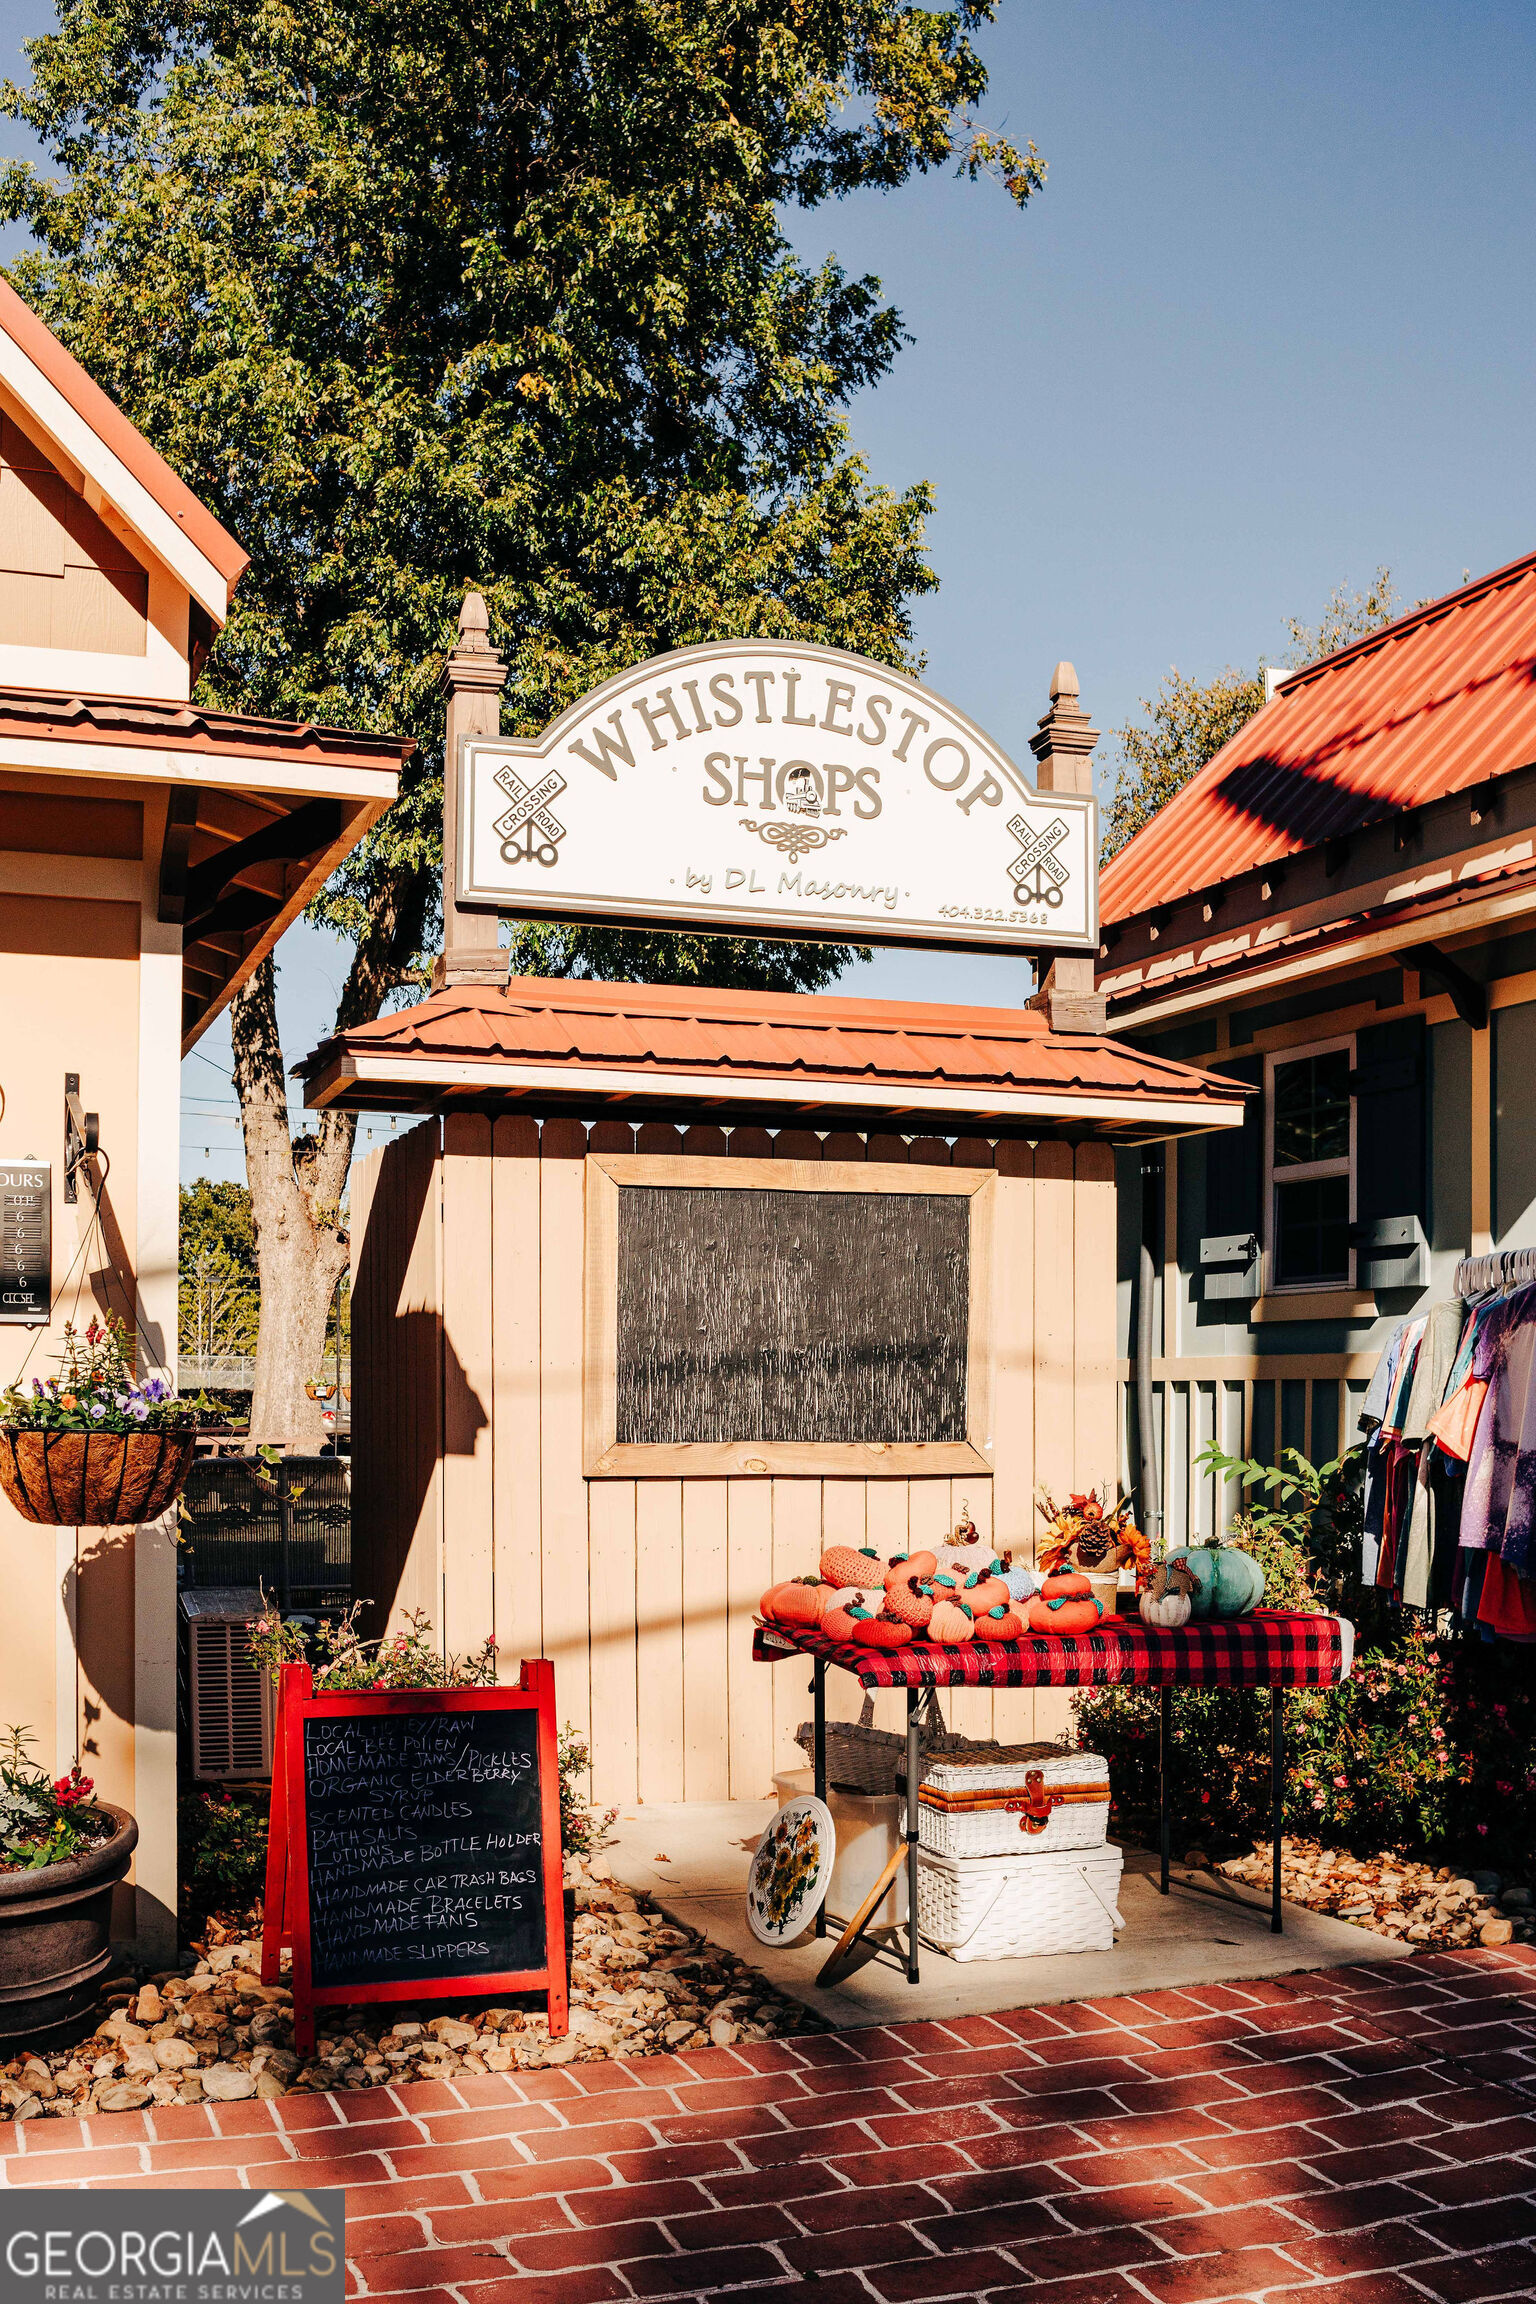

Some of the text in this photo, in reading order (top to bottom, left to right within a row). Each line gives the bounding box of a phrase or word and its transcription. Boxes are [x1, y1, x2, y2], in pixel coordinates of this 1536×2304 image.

[567, 670, 1003, 817] WHISTLESTOP
[499, 771, 523, 799] RAIL
[703, 752, 883, 819] SHOPS
[502, 778, 558, 831] CROSSING
[535, 811, 560, 837] ROAD
[1011, 820, 1033, 845] RAIL
[1015, 826, 1062, 875] CROSSING
[1043, 856, 1064, 880] ROAD
[686, 867, 898, 910] by DL Masonry
[938, 904, 1048, 925] 404.322.5368
[306, 1721, 362, 1740] LOCAL
[306, 1739, 355, 1757] LOCAL
[362, 1738, 394, 1754] BEE
[307, 1752, 409, 1780] HOMEMADE
[309, 1773, 402, 1798] ORGANIC
[370, 1789, 433, 1804] SYRUP
[309, 1801, 473, 1828] SCENTED CANDLES
[312, 1825, 419, 1851] BATH SALTS
[310, 1832, 542, 1888] HANDMADE BOTTLE HOLDER
[313, 1843, 394, 1868] LOTIONS
[316, 1869, 537, 1910] HANDMADE CAR TRASH BAGS
[313, 1895, 524, 1930] HANDMADE BRACELETS
[316, 1912, 479, 1949] HANDMADE FANS
[407, 1941, 490, 1960] SLIPPERS
